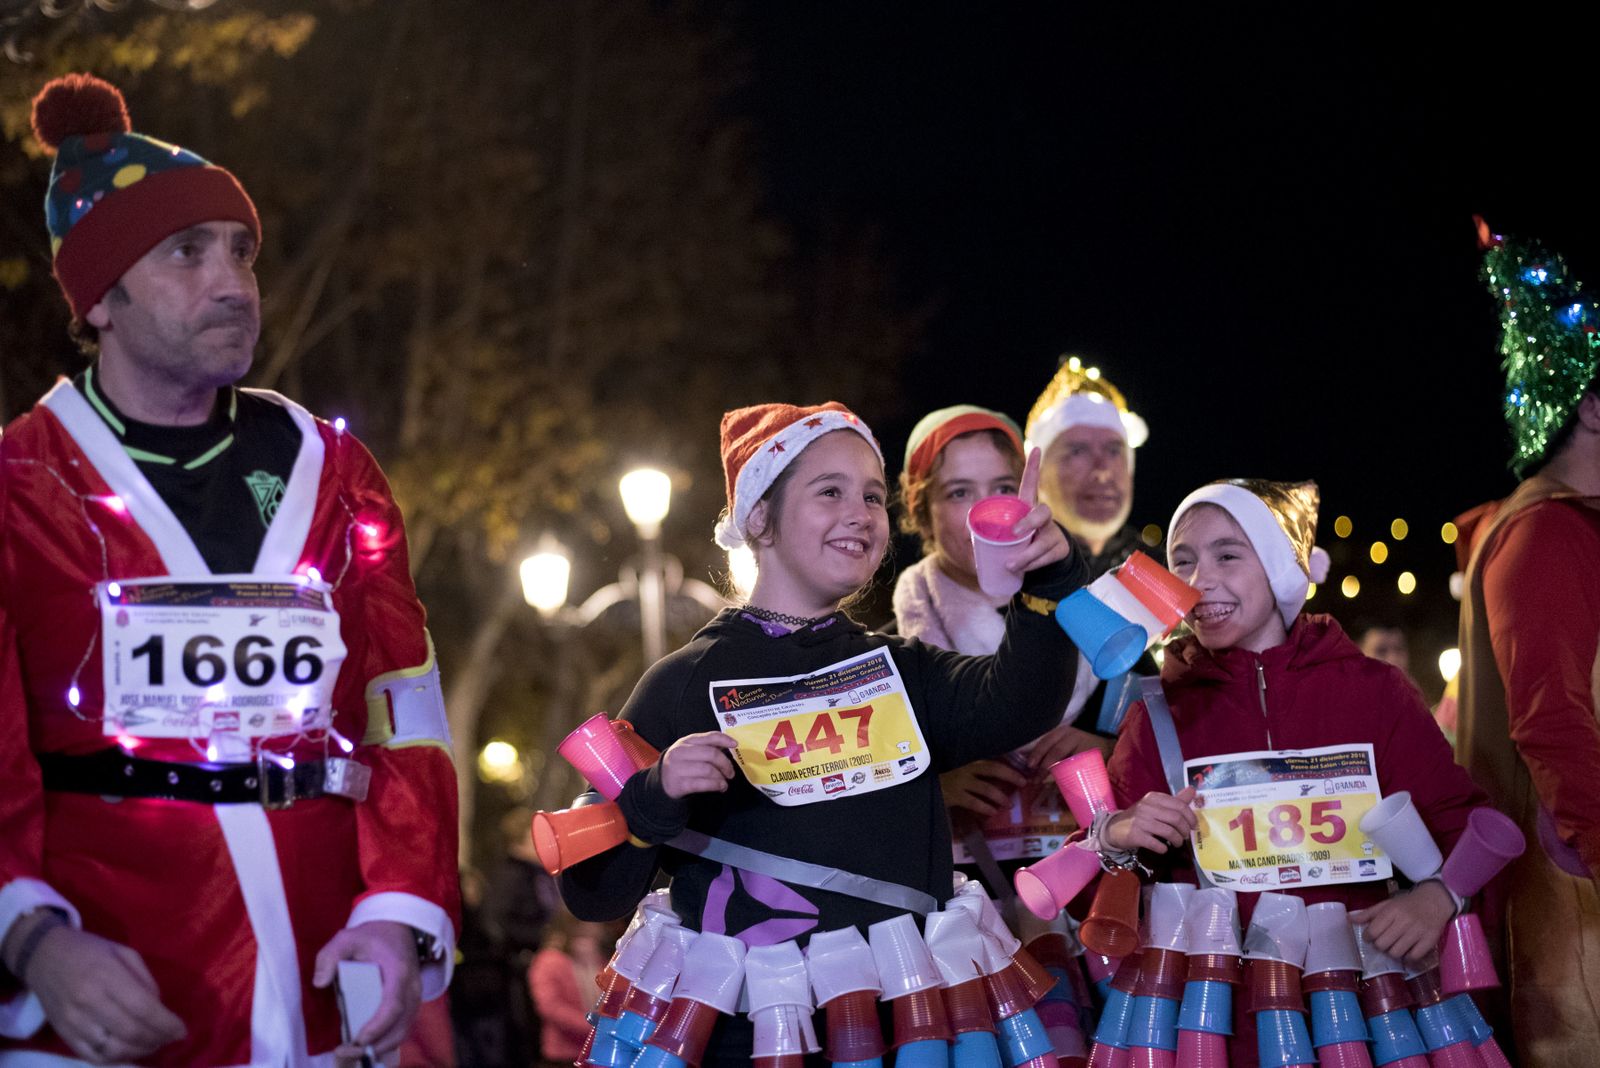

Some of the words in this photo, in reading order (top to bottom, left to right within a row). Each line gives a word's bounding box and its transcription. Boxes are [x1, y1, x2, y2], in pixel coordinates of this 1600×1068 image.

[132, 634, 324, 687] 1666
[837, 663, 867, 677] diciembre
[867, 657, 883, 667] 2018
[860, 664, 886, 676] Granada
[719, 688, 739, 711] 27
[738, 687, 763, 700] Carrera
[860, 682, 892, 699] GRANADA
[730, 692, 767, 710] Nocturna
[764, 705, 874, 764] 447
[1319, 753, 1350, 762] diciembre
[770, 769, 799, 784] CLAUDIA
[798, 764, 822, 779] PEREZ
[821, 759, 849, 774] TERRON
[849, 753, 873, 769] (2009)
[1334, 779, 1367, 791] GRANADA
[1228, 800, 1347, 852] 185
[1257, 855, 1276, 867] CANO
